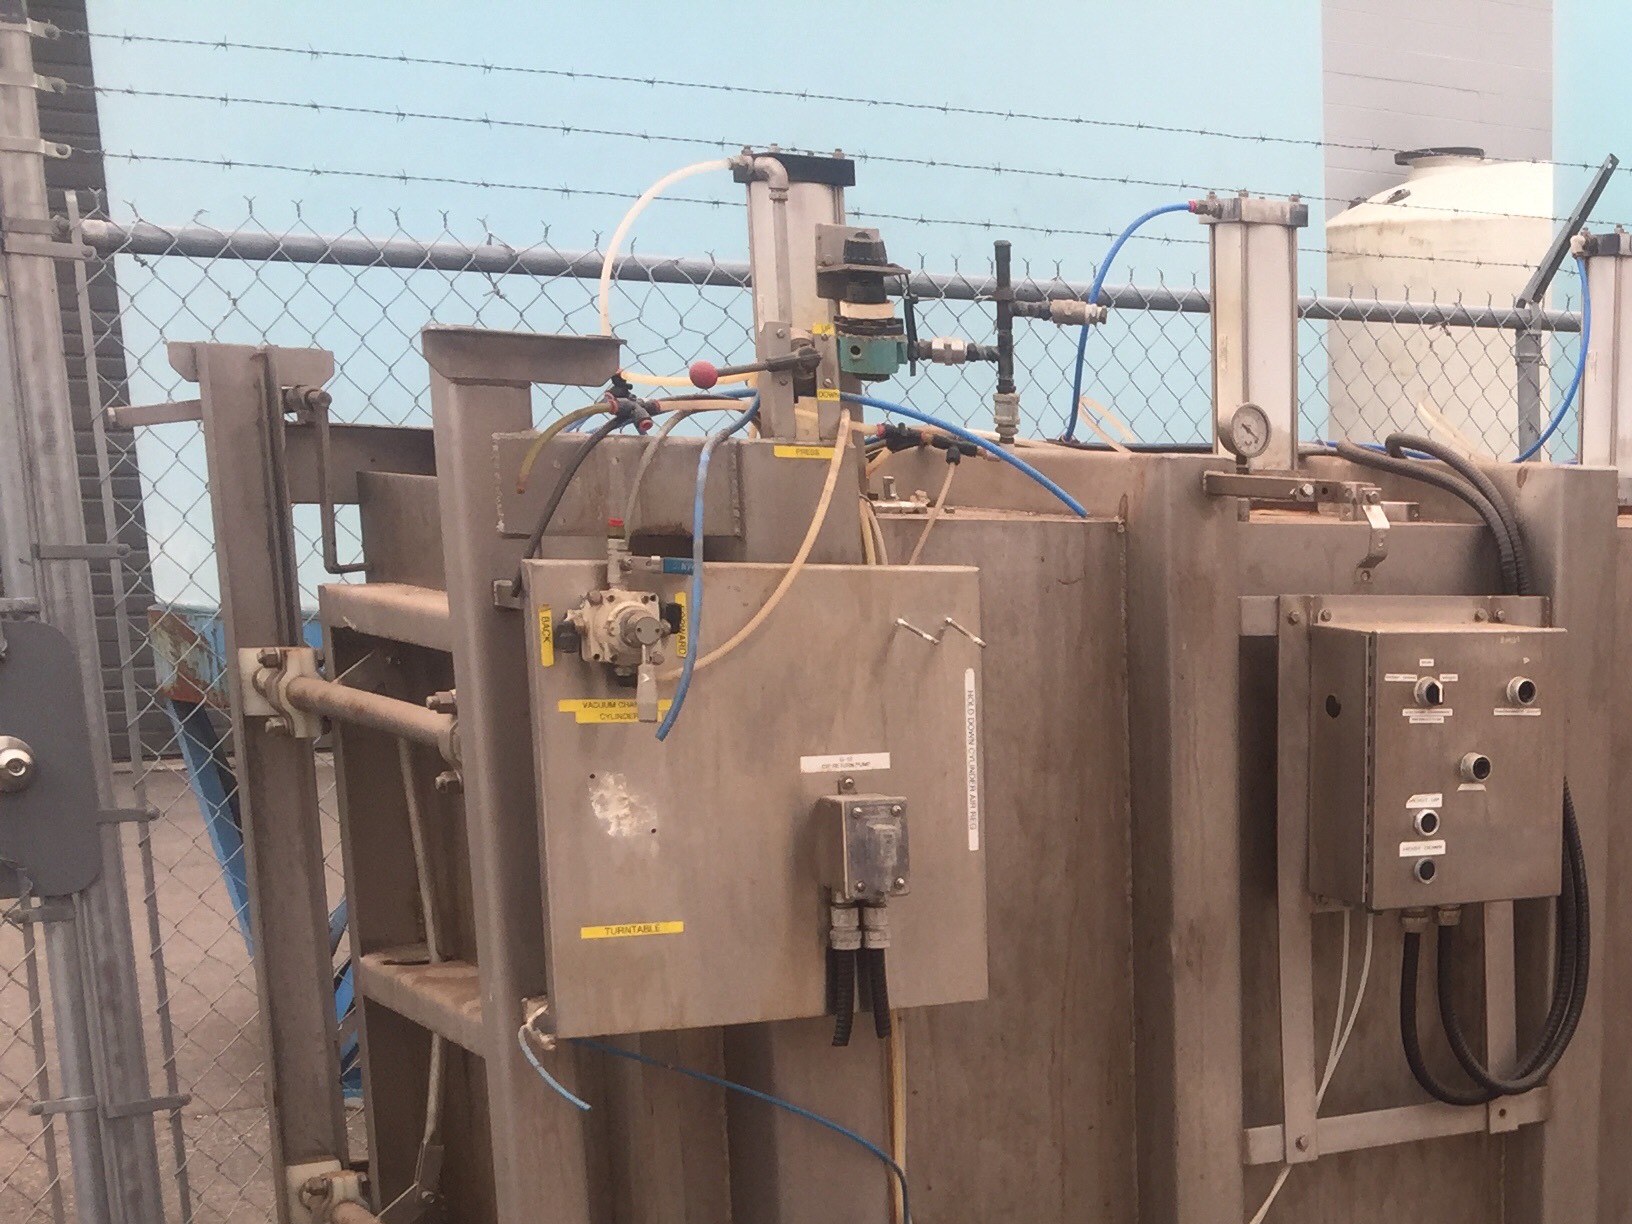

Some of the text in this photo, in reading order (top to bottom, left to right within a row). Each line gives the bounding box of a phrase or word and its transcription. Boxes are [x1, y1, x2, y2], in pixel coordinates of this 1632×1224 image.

[541, 616, 551, 643] BACK
[583, 701, 616, 709] VACUUM
[967, 717, 975, 745] DOWN
[968, 747, 977, 792] CYLINDER
[970, 794, 978, 809] AIR
[970, 811, 979, 830] REG
[604, 925, 660, 935] TURNTABLE
